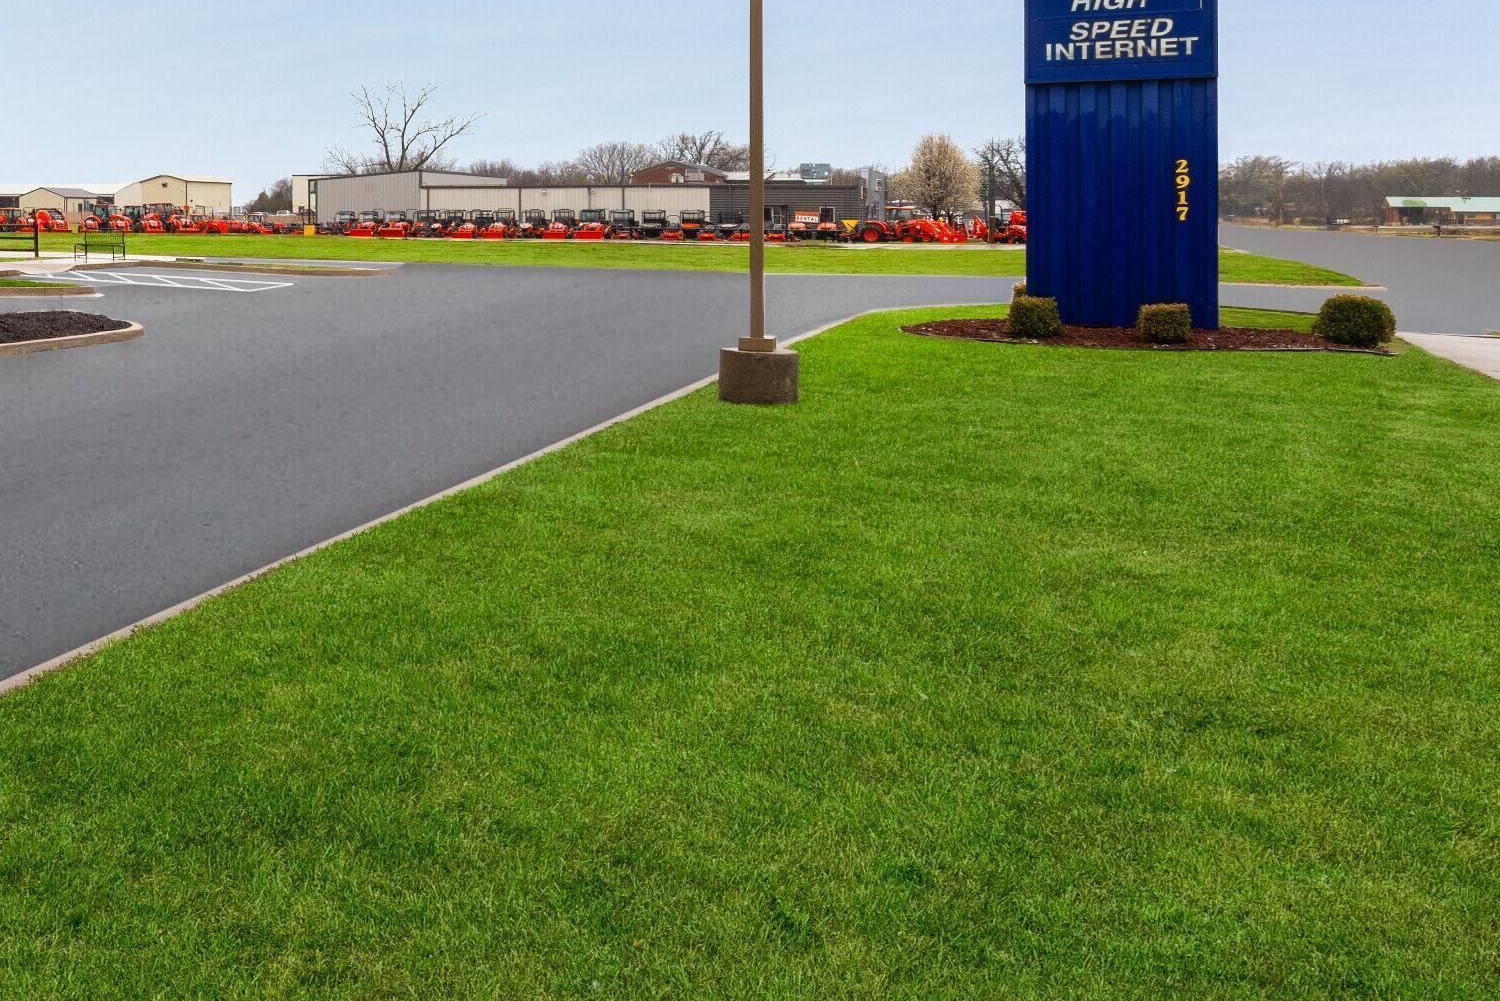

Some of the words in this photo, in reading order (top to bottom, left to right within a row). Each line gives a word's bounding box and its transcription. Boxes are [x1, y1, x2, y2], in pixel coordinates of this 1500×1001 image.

[1069, 17, 1173, 41] SPEED
[1046, 36, 1199, 61] INTERNET
[1176, 159, 1190, 221] 2917
